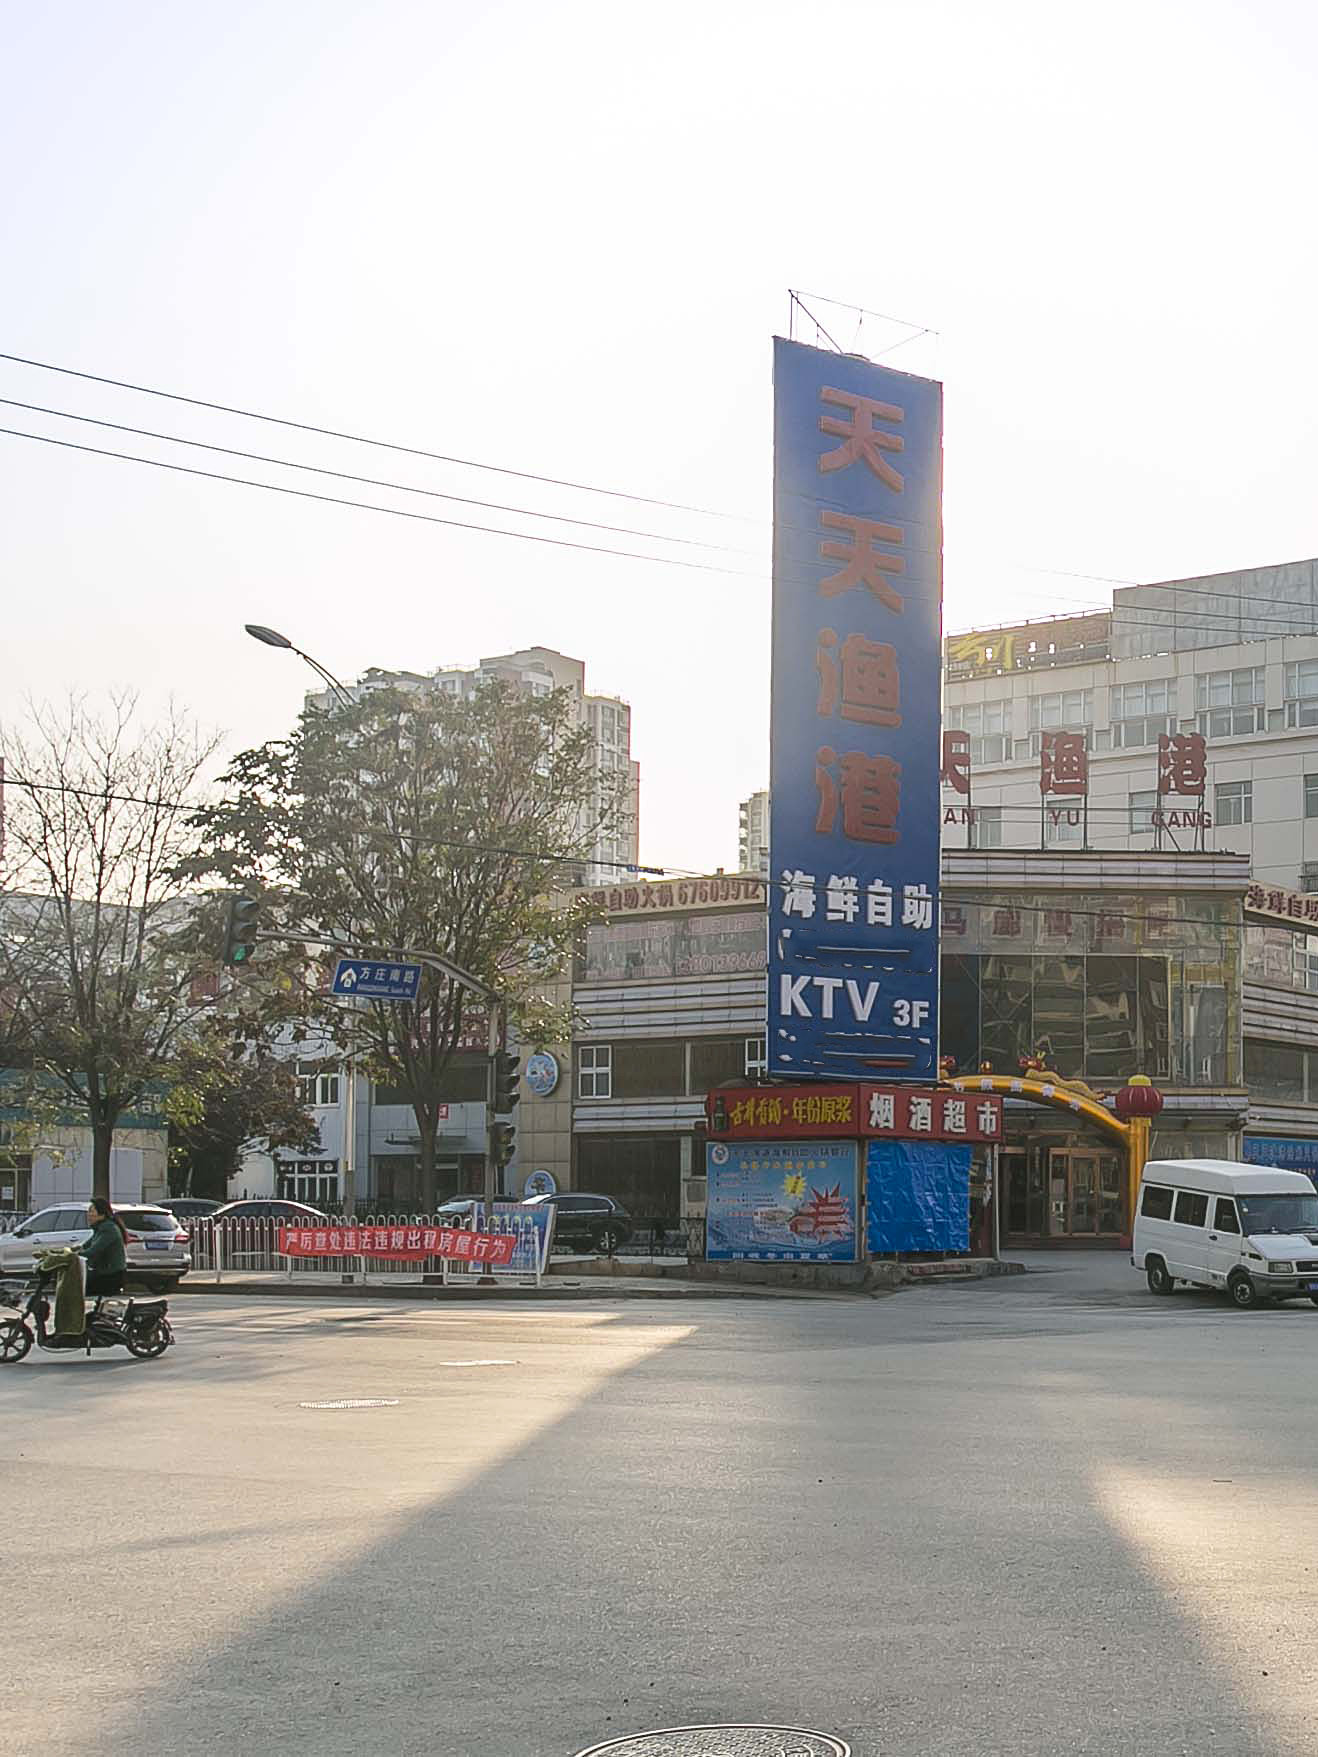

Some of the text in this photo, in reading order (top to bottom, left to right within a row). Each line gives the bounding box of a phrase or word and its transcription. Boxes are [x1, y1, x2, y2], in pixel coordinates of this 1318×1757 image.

[815, 384, 904, 845] 天天渔港
[1049, 811, 1081, 827] YU
[1151, 811, 1213, 829] GANG
[779, 869, 933, 930] 海鲜自助
[359, 966, 416, 984] 方庄南路
[780, 973, 930, 1029] KTV 3F
[869, 1092, 998, 1135] 烟酒超市
[284, 1229, 507, 1259] 严厉查处违法违规出租房屋行为
